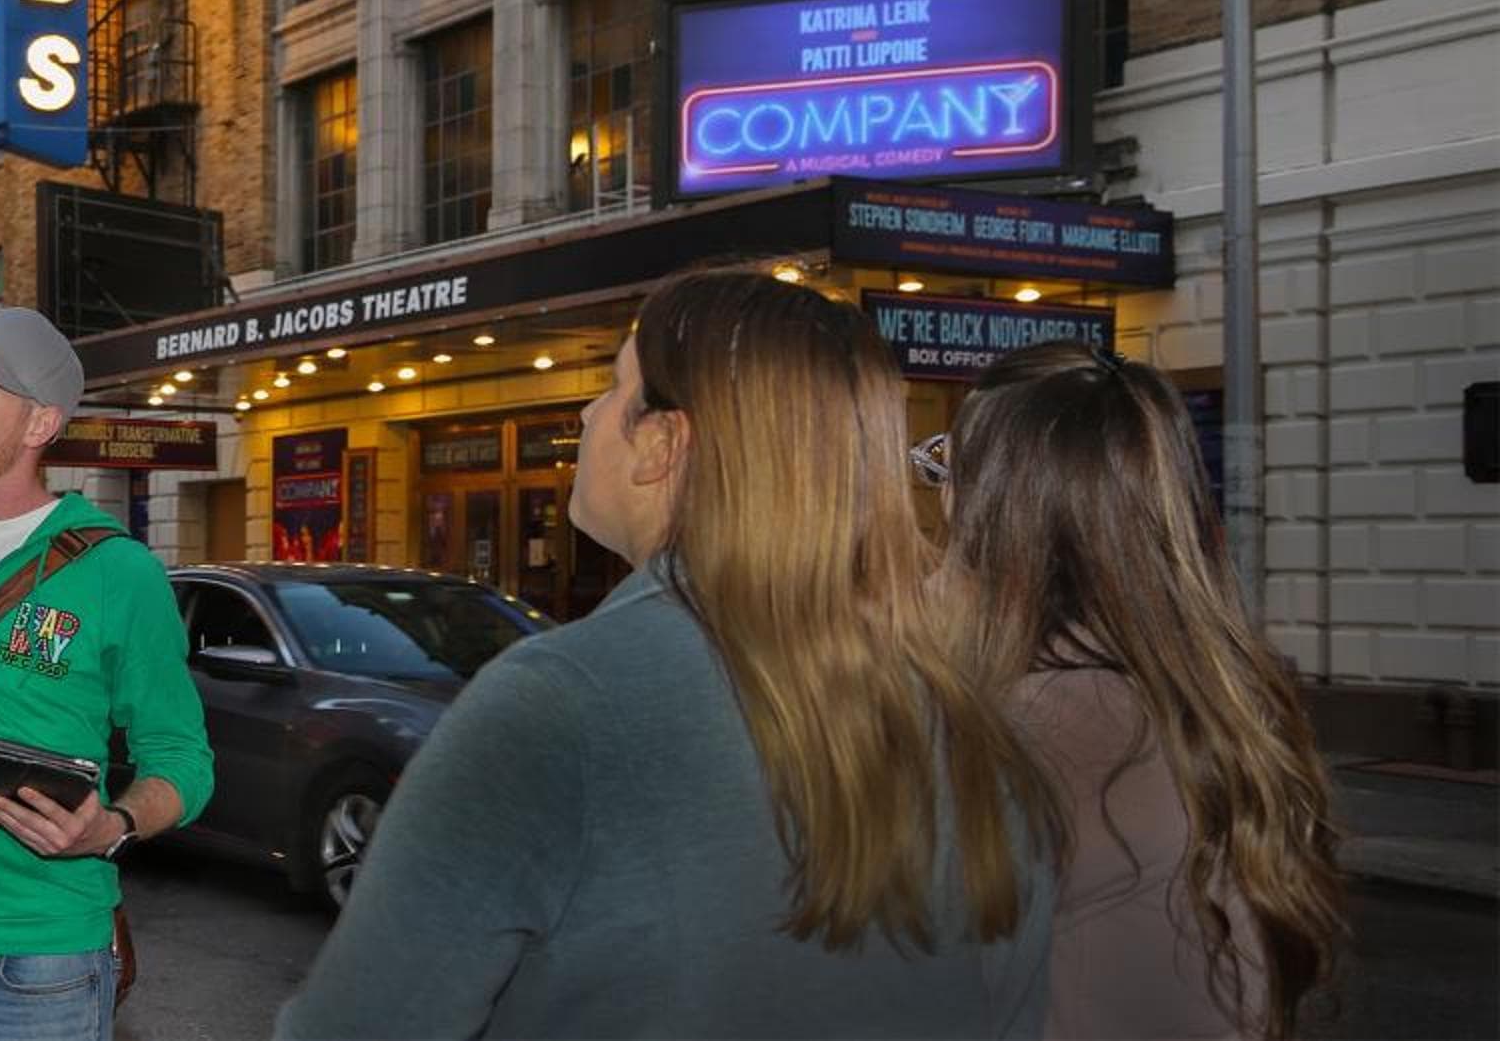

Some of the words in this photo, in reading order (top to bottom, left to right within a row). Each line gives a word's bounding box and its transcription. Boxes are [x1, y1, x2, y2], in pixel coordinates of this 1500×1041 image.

[800, 2, 878, 35] KATRINA
[801, 43, 852, 72] PATTI
[856, 37, 929, 67] LUPONE
[698, 72, 1042, 156] COMPANY
[873, 147, 945, 167] COMEDY
[850, 203, 902, 231] STEPHEN
[156, 323, 240, 360] BERNARD
[246, 317, 263, 342] B.
[269, 299, 354, 339] JACOBS
[362, 276, 469, 322] THEATRE
[877, 307, 936, 342] WE'RE
[940, 312, 985, 347] BACK
[909, 347, 940, 365] BOX
